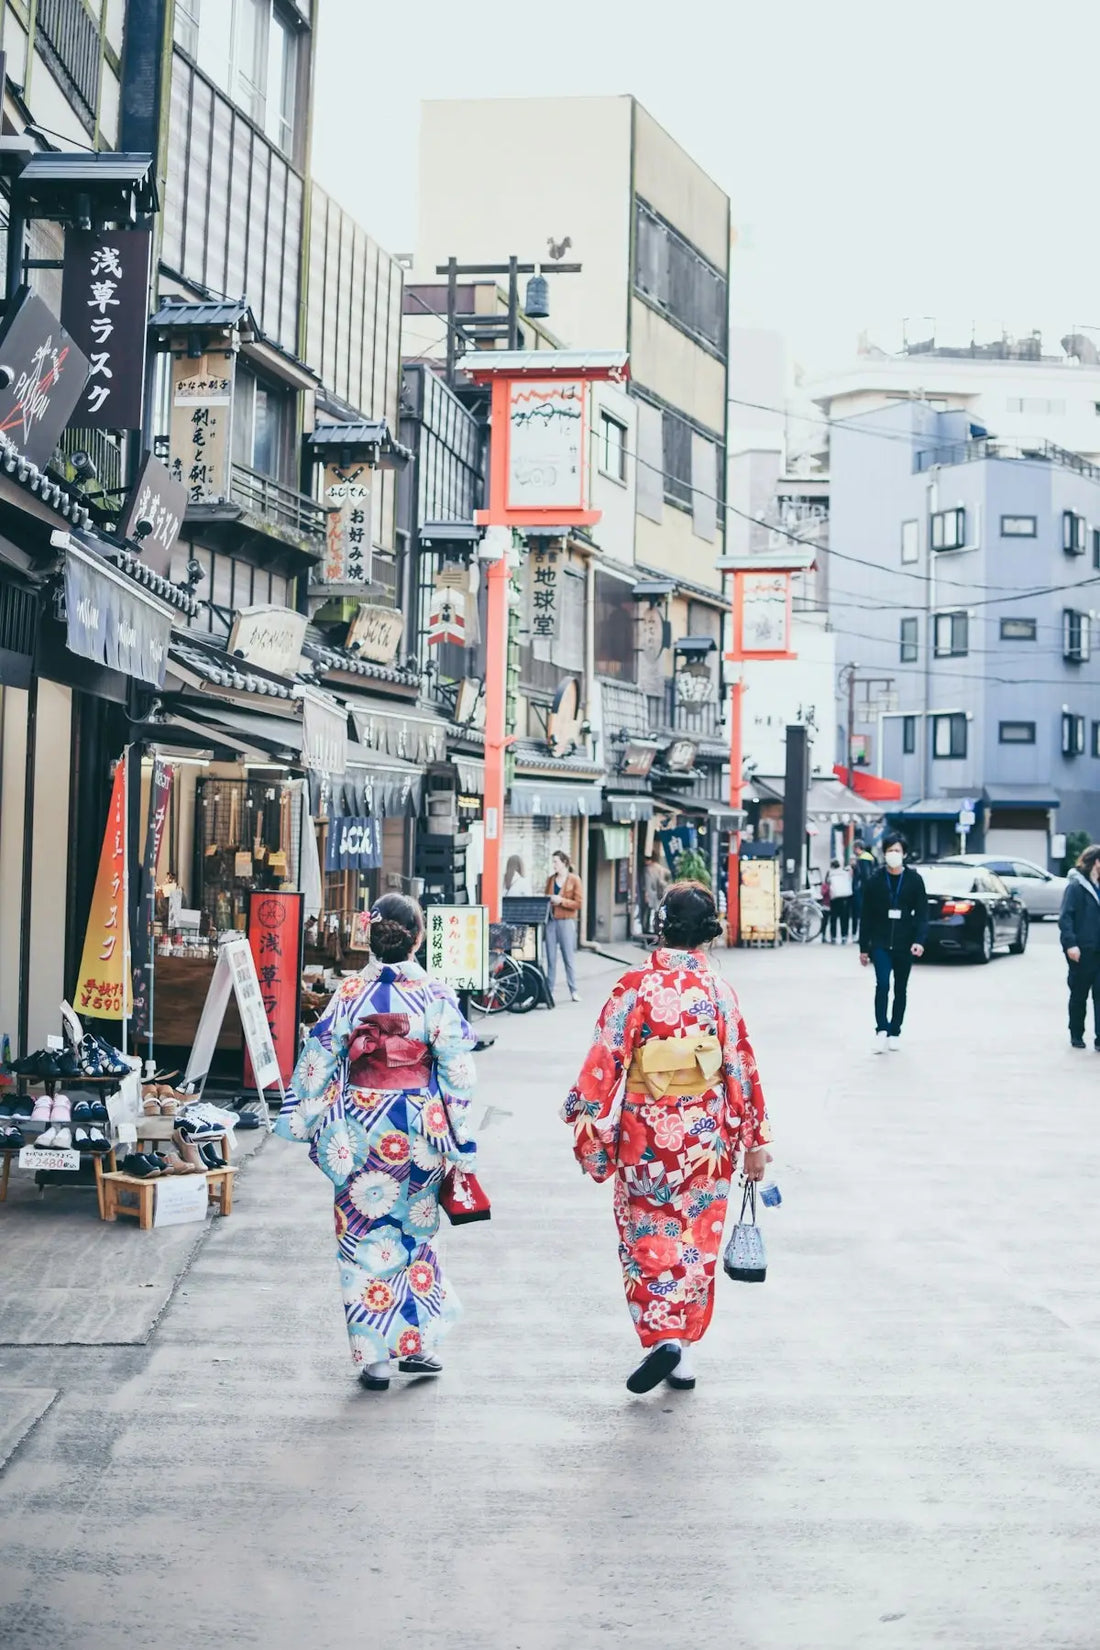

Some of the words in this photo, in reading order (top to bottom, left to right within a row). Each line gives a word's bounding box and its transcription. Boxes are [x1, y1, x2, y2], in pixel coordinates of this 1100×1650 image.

[87, 246, 123, 413] 浅草ラスク
[188, 408, 209, 501] 刷毛と刷子
[328, 487, 368, 497] ふじでん
[347, 508, 365, 580] お好み焼
[532, 565, 557, 636] 地球堂
